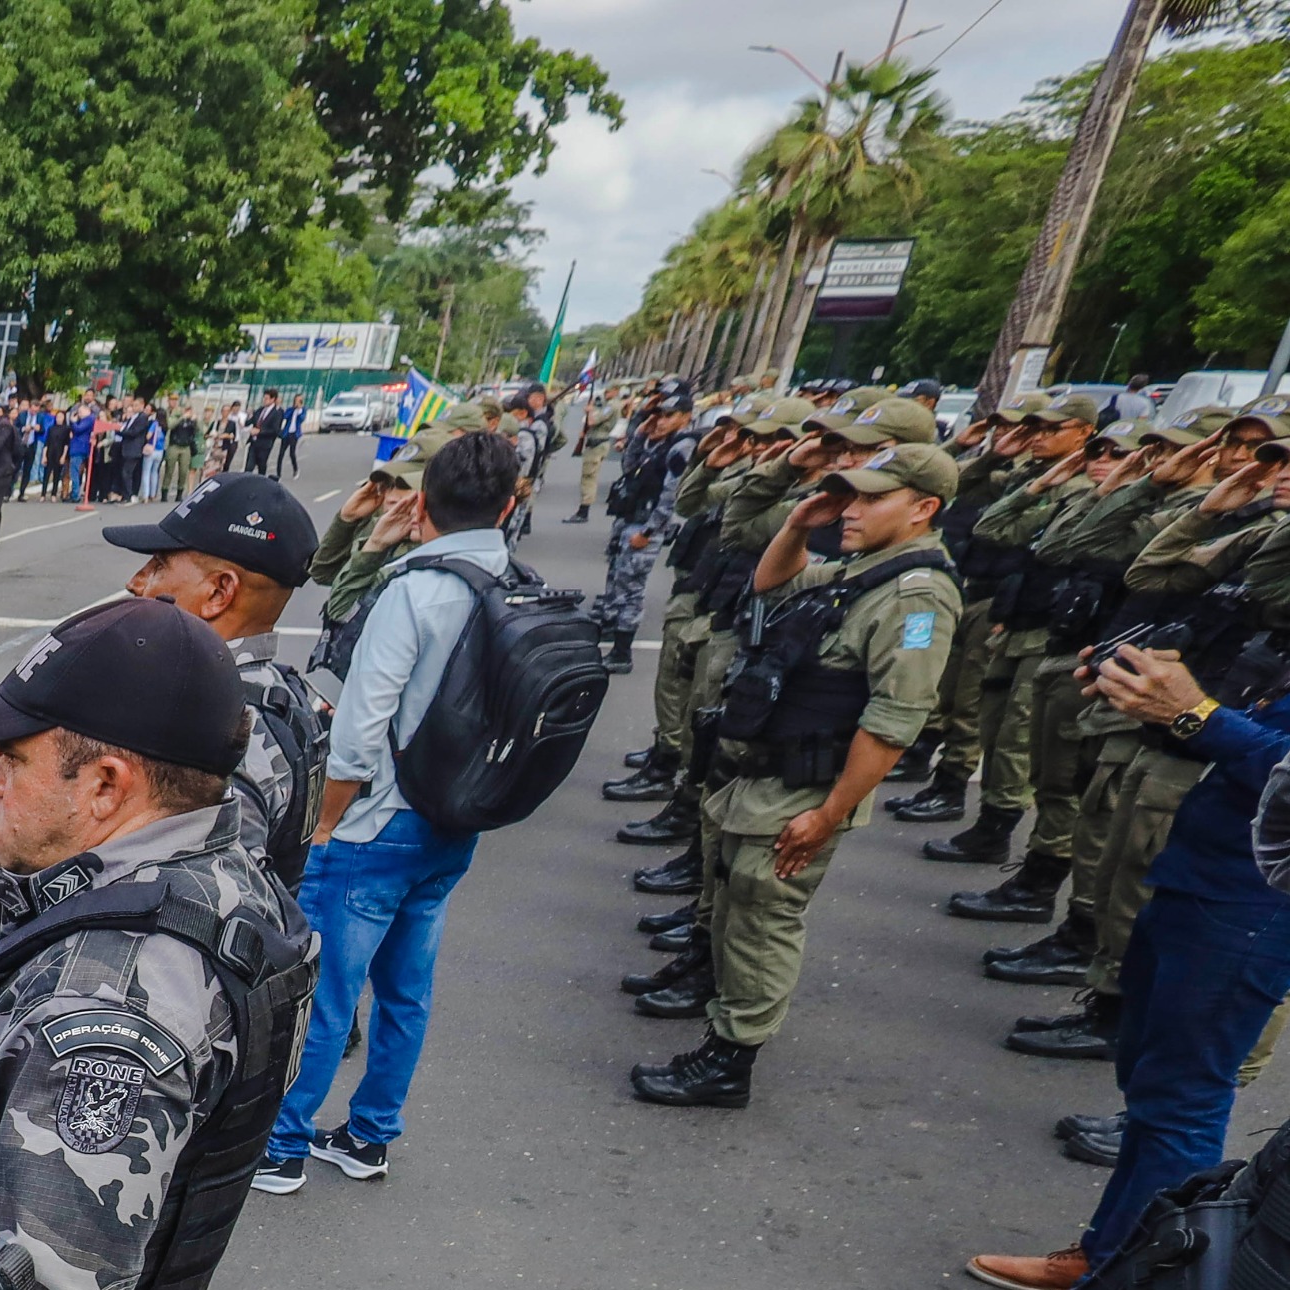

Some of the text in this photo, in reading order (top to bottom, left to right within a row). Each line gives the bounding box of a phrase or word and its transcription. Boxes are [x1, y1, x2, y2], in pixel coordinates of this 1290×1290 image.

[227, 523, 268, 540] EVANGELISTA
[52, 1023, 171, 1065] OPERAÇÕES RONE
[72, 1058, 146, 1085] RONE
